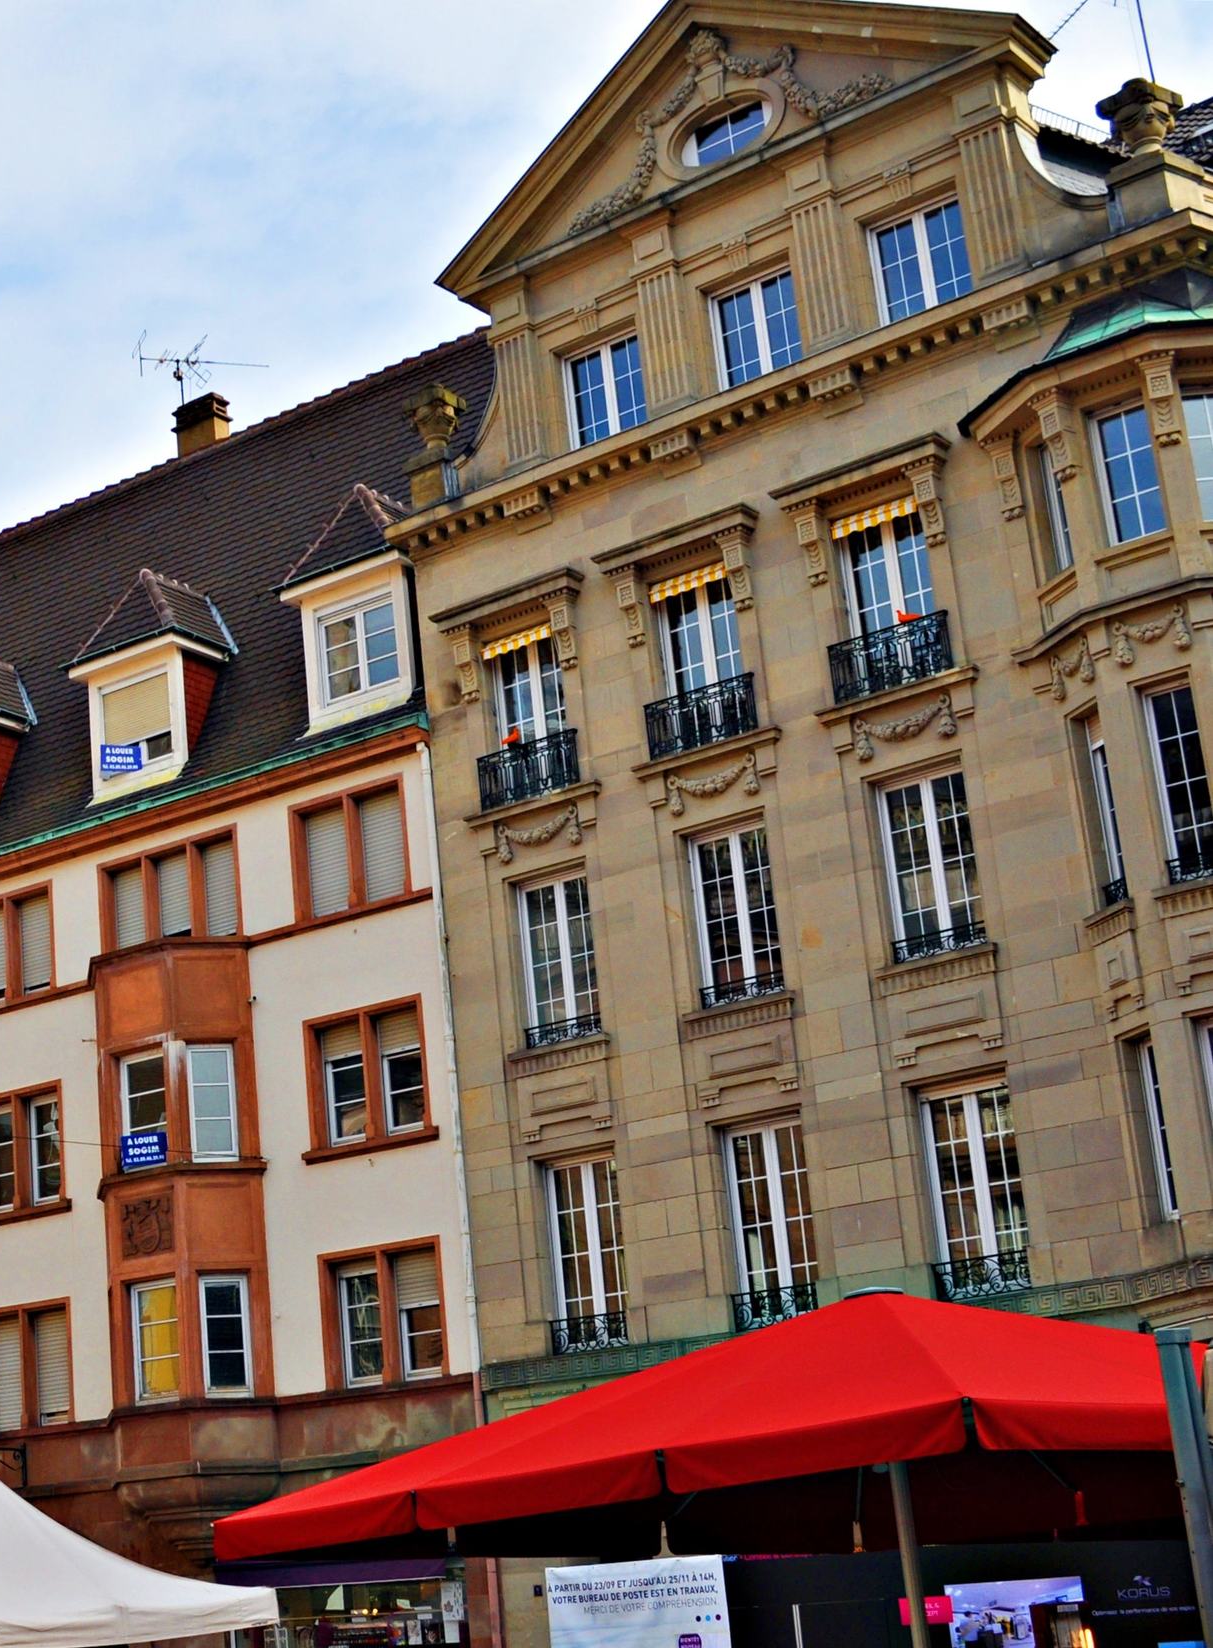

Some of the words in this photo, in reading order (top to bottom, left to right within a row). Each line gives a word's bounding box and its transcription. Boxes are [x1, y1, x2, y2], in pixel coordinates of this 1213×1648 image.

[112, 747, 133, 755] LOUER
[127, 1138, 134, 1146] A
[134, 1135, 159, 1145] LOUER
[128, 1145, 160, 1156] SOGIM
[554, 1583, 581, 1593] PARTIR
[582, 1582, 593, 1592] DU
[594, 1581, 615, 1591] 23/09
[617, 1579, 627, 1589] ET
[628, 1576, 667, 1588] JUSQU'AU
[668, 1574, 690, 1585] 25/11
[691, 1570, 698, 1582] À
[552, 1594, 577, 1605] VOTRE
[578, 1592, 609, 1603] BUREAU
[610, 1591, 621, 1601] DE
[622, 1590, 649, 1600] POSTE
[650, 1588, 665, 1598] EST
[667, 1587, 678, 1597] EN
[1117, 1586, 1171, 1599] KORUS
[583, 1604, 608, 1615] MERCI
[609, 1603, 620, 1613] DE
[621, 1601, 646, 1612] VOTRE
